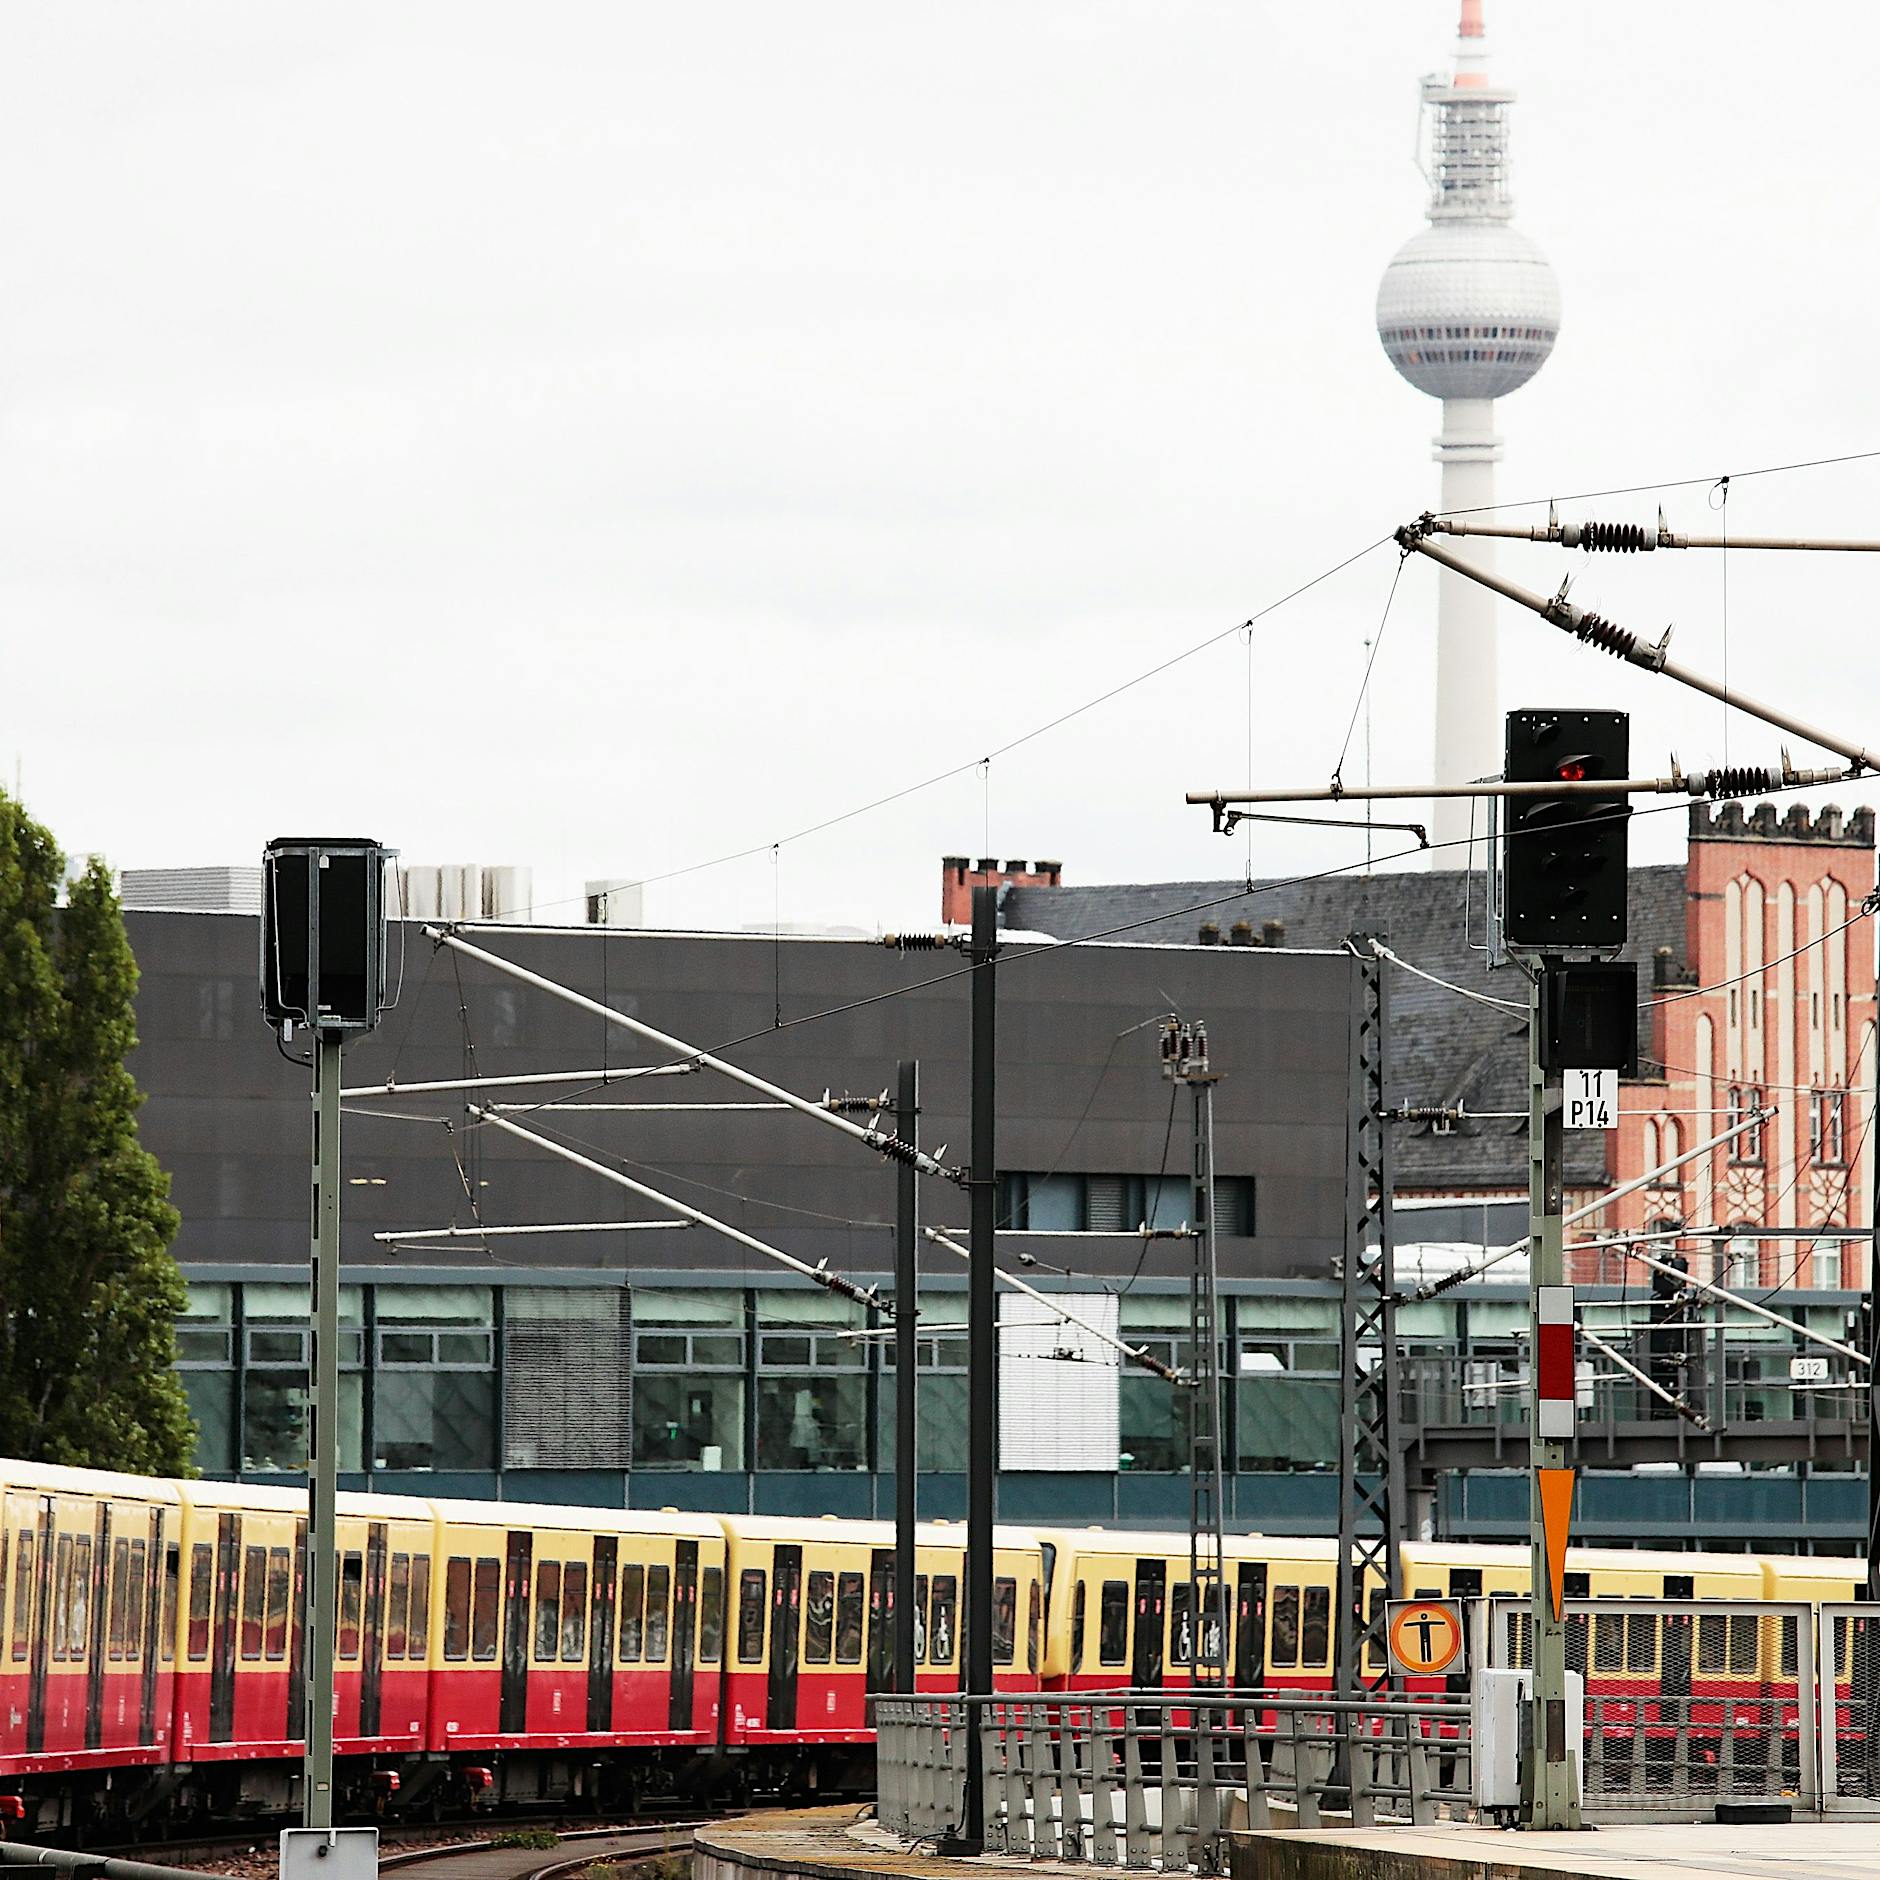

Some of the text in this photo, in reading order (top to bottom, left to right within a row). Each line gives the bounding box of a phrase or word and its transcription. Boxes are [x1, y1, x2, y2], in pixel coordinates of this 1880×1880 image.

[1581, 1072, 1601, 1098] 11
[1571, 1100, 1610, 1126] P14
[1797, 1362, 1821, 1376] 312
